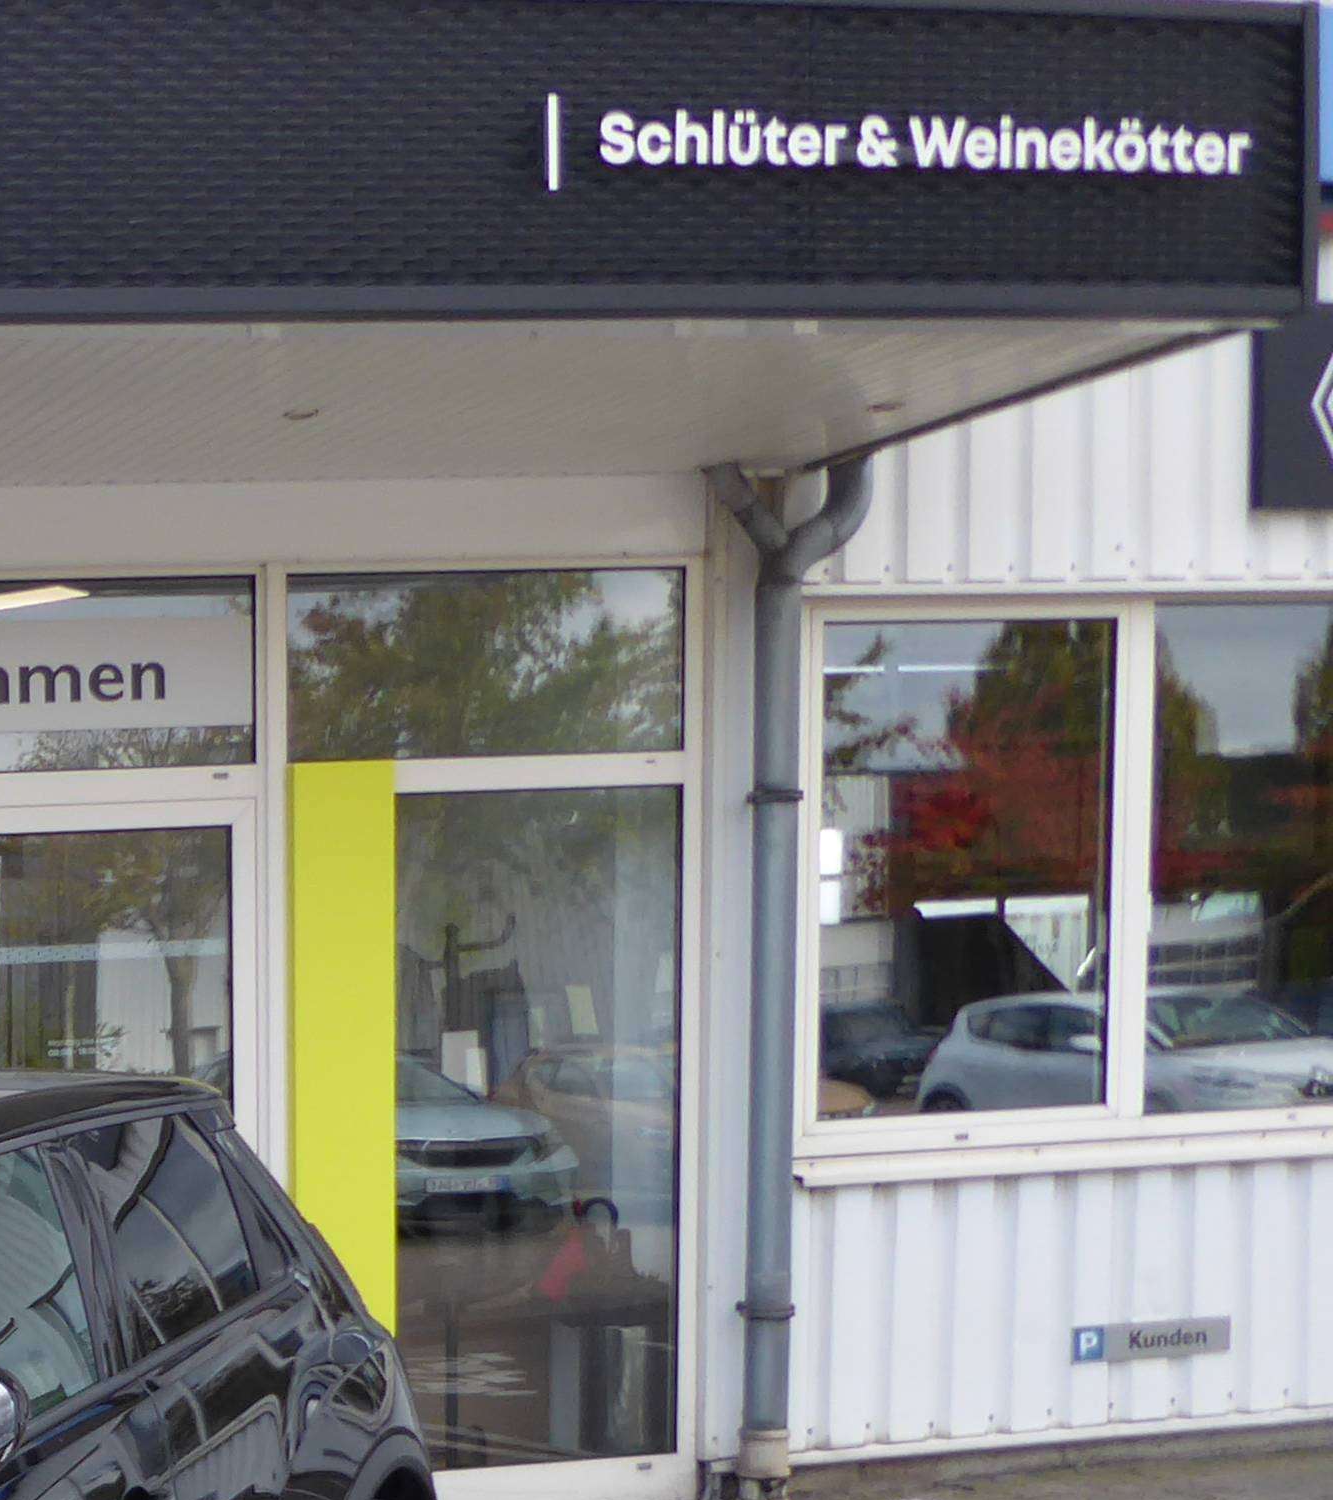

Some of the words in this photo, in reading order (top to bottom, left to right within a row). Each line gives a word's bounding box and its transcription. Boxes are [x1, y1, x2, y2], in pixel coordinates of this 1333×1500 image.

[599, 110, 848, 167] Schlüter
[856, 115, 898, 168] &
[908, 115, 1252, 175] Weinekötter
[1080, 1331, 1098, 1356] P
[1128, 1328, 1208, 1350] Kunden
